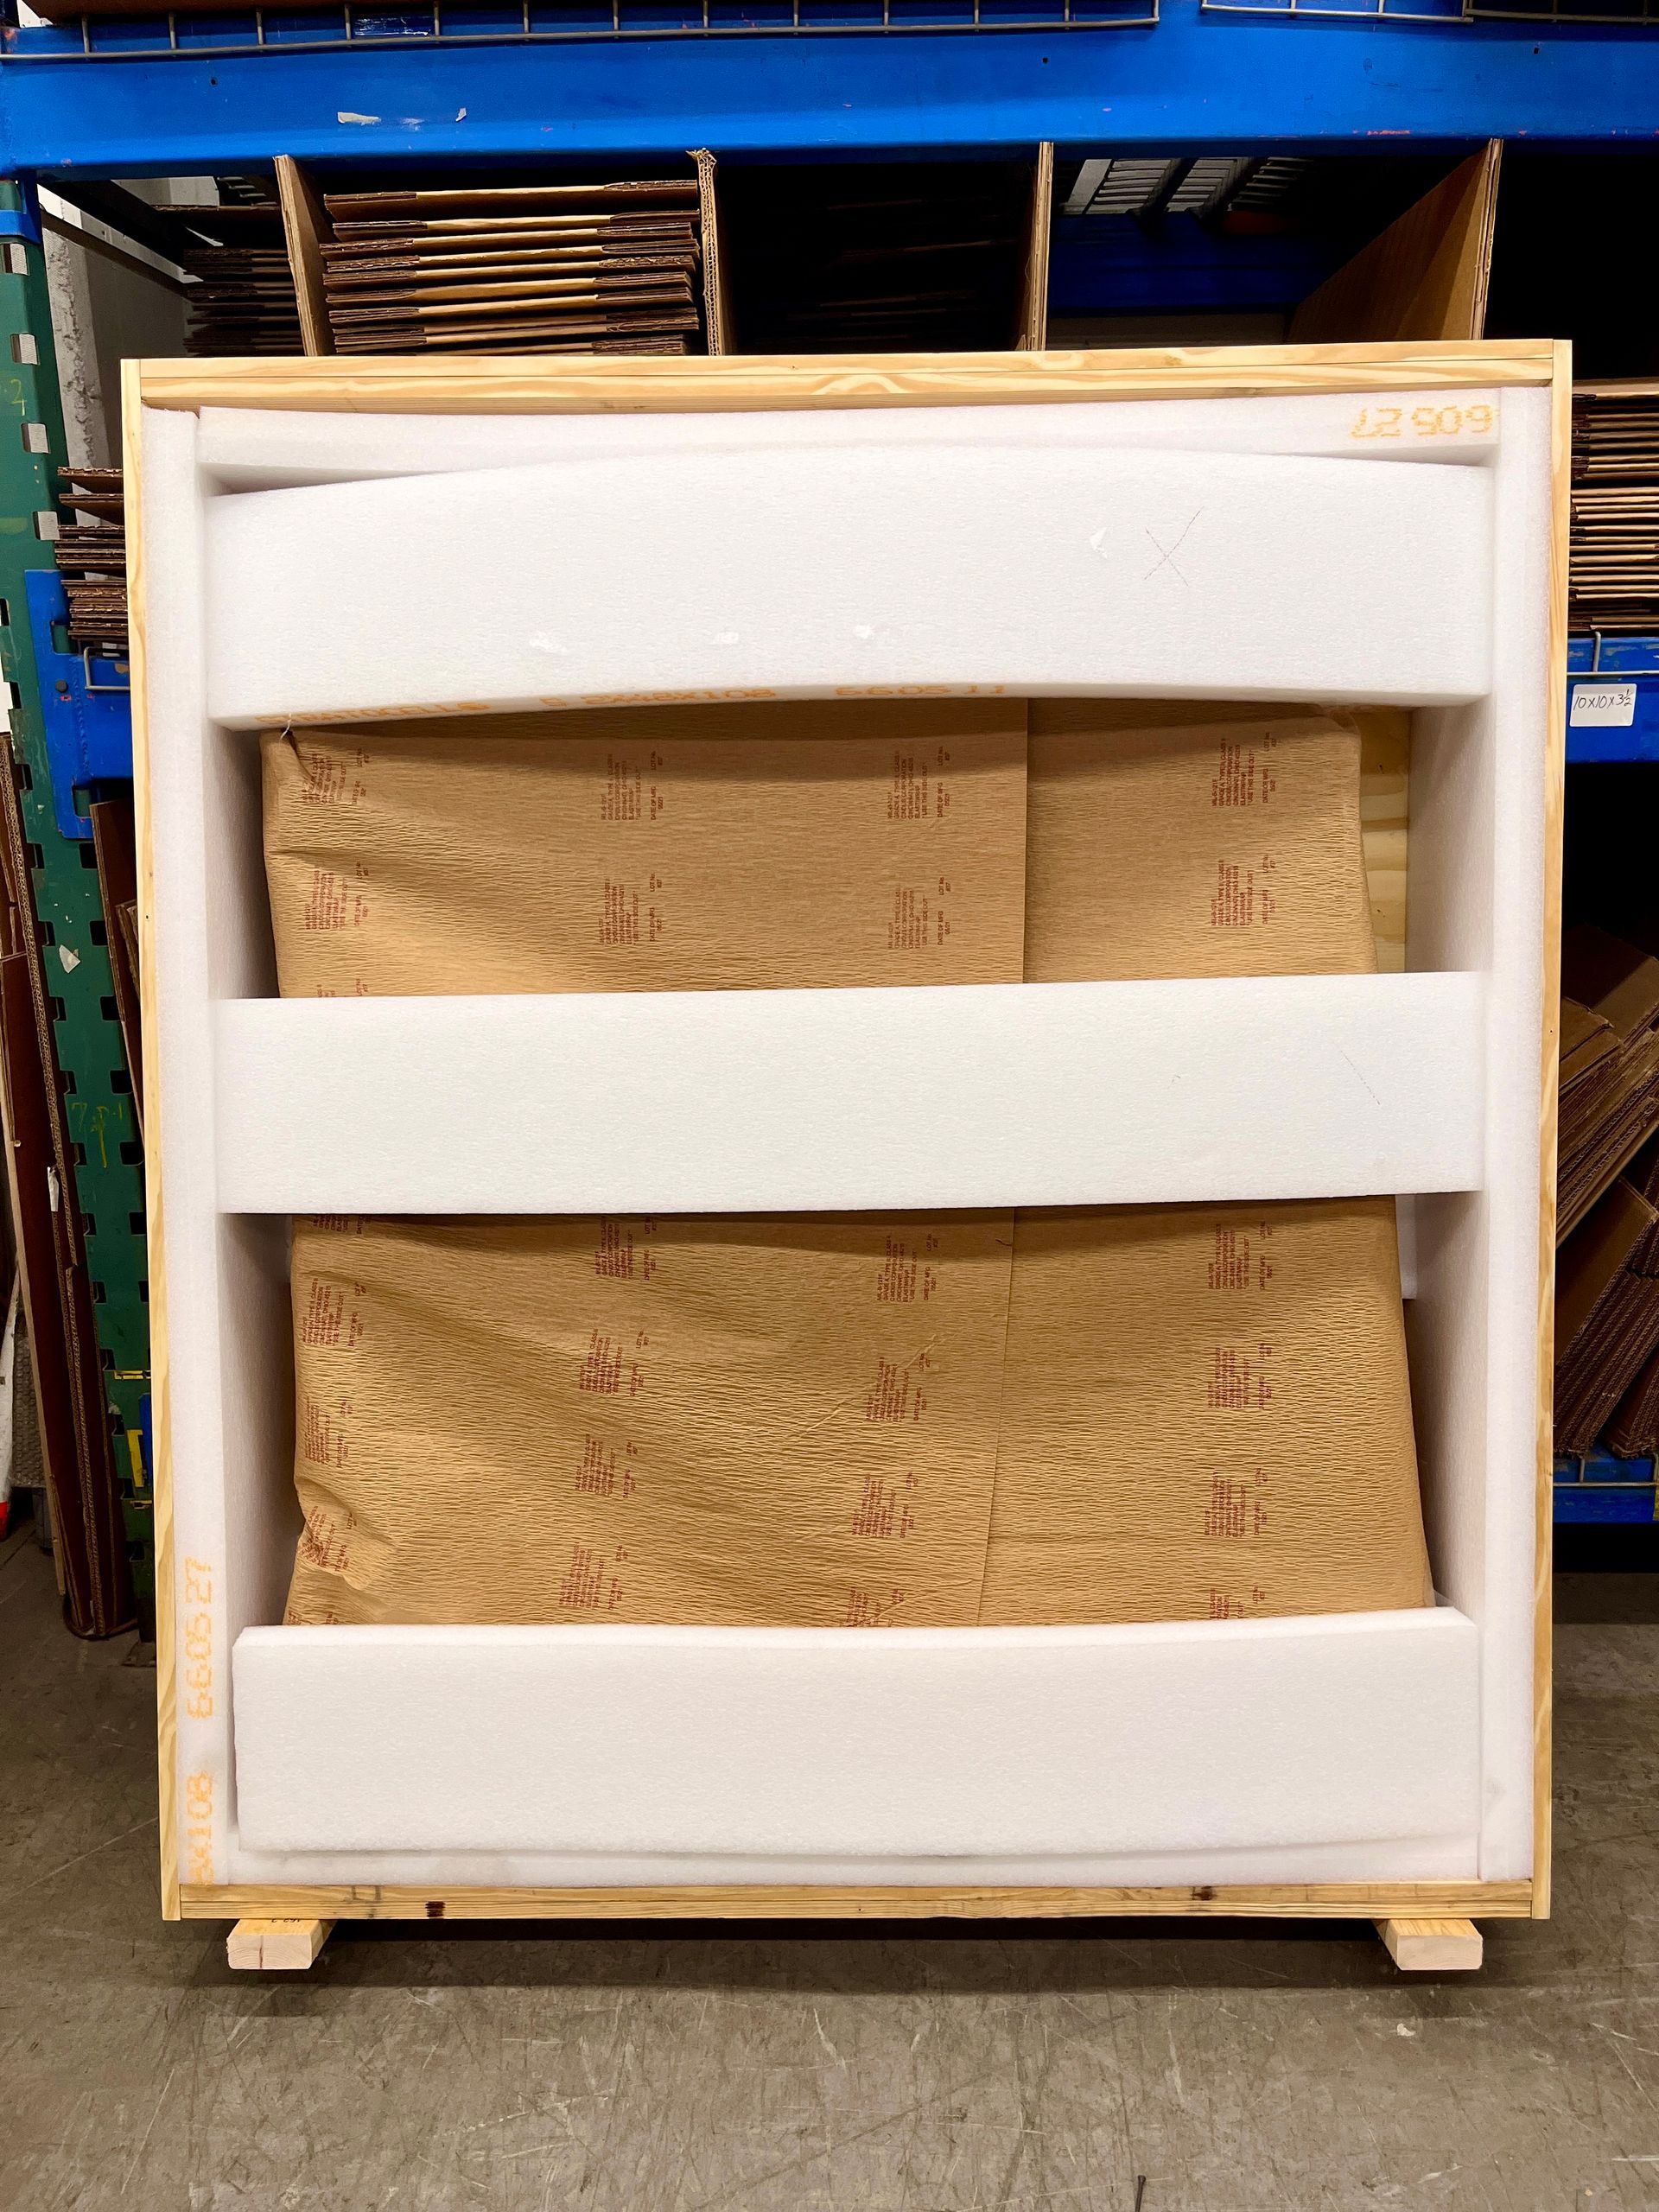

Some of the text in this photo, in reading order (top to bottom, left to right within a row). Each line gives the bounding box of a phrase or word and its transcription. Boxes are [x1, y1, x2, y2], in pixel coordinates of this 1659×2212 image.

[1411, 404, 1500, 435] 605
[183, 1555, 213, 1605] 27
[184, 1612, 214, 1719] 6605
